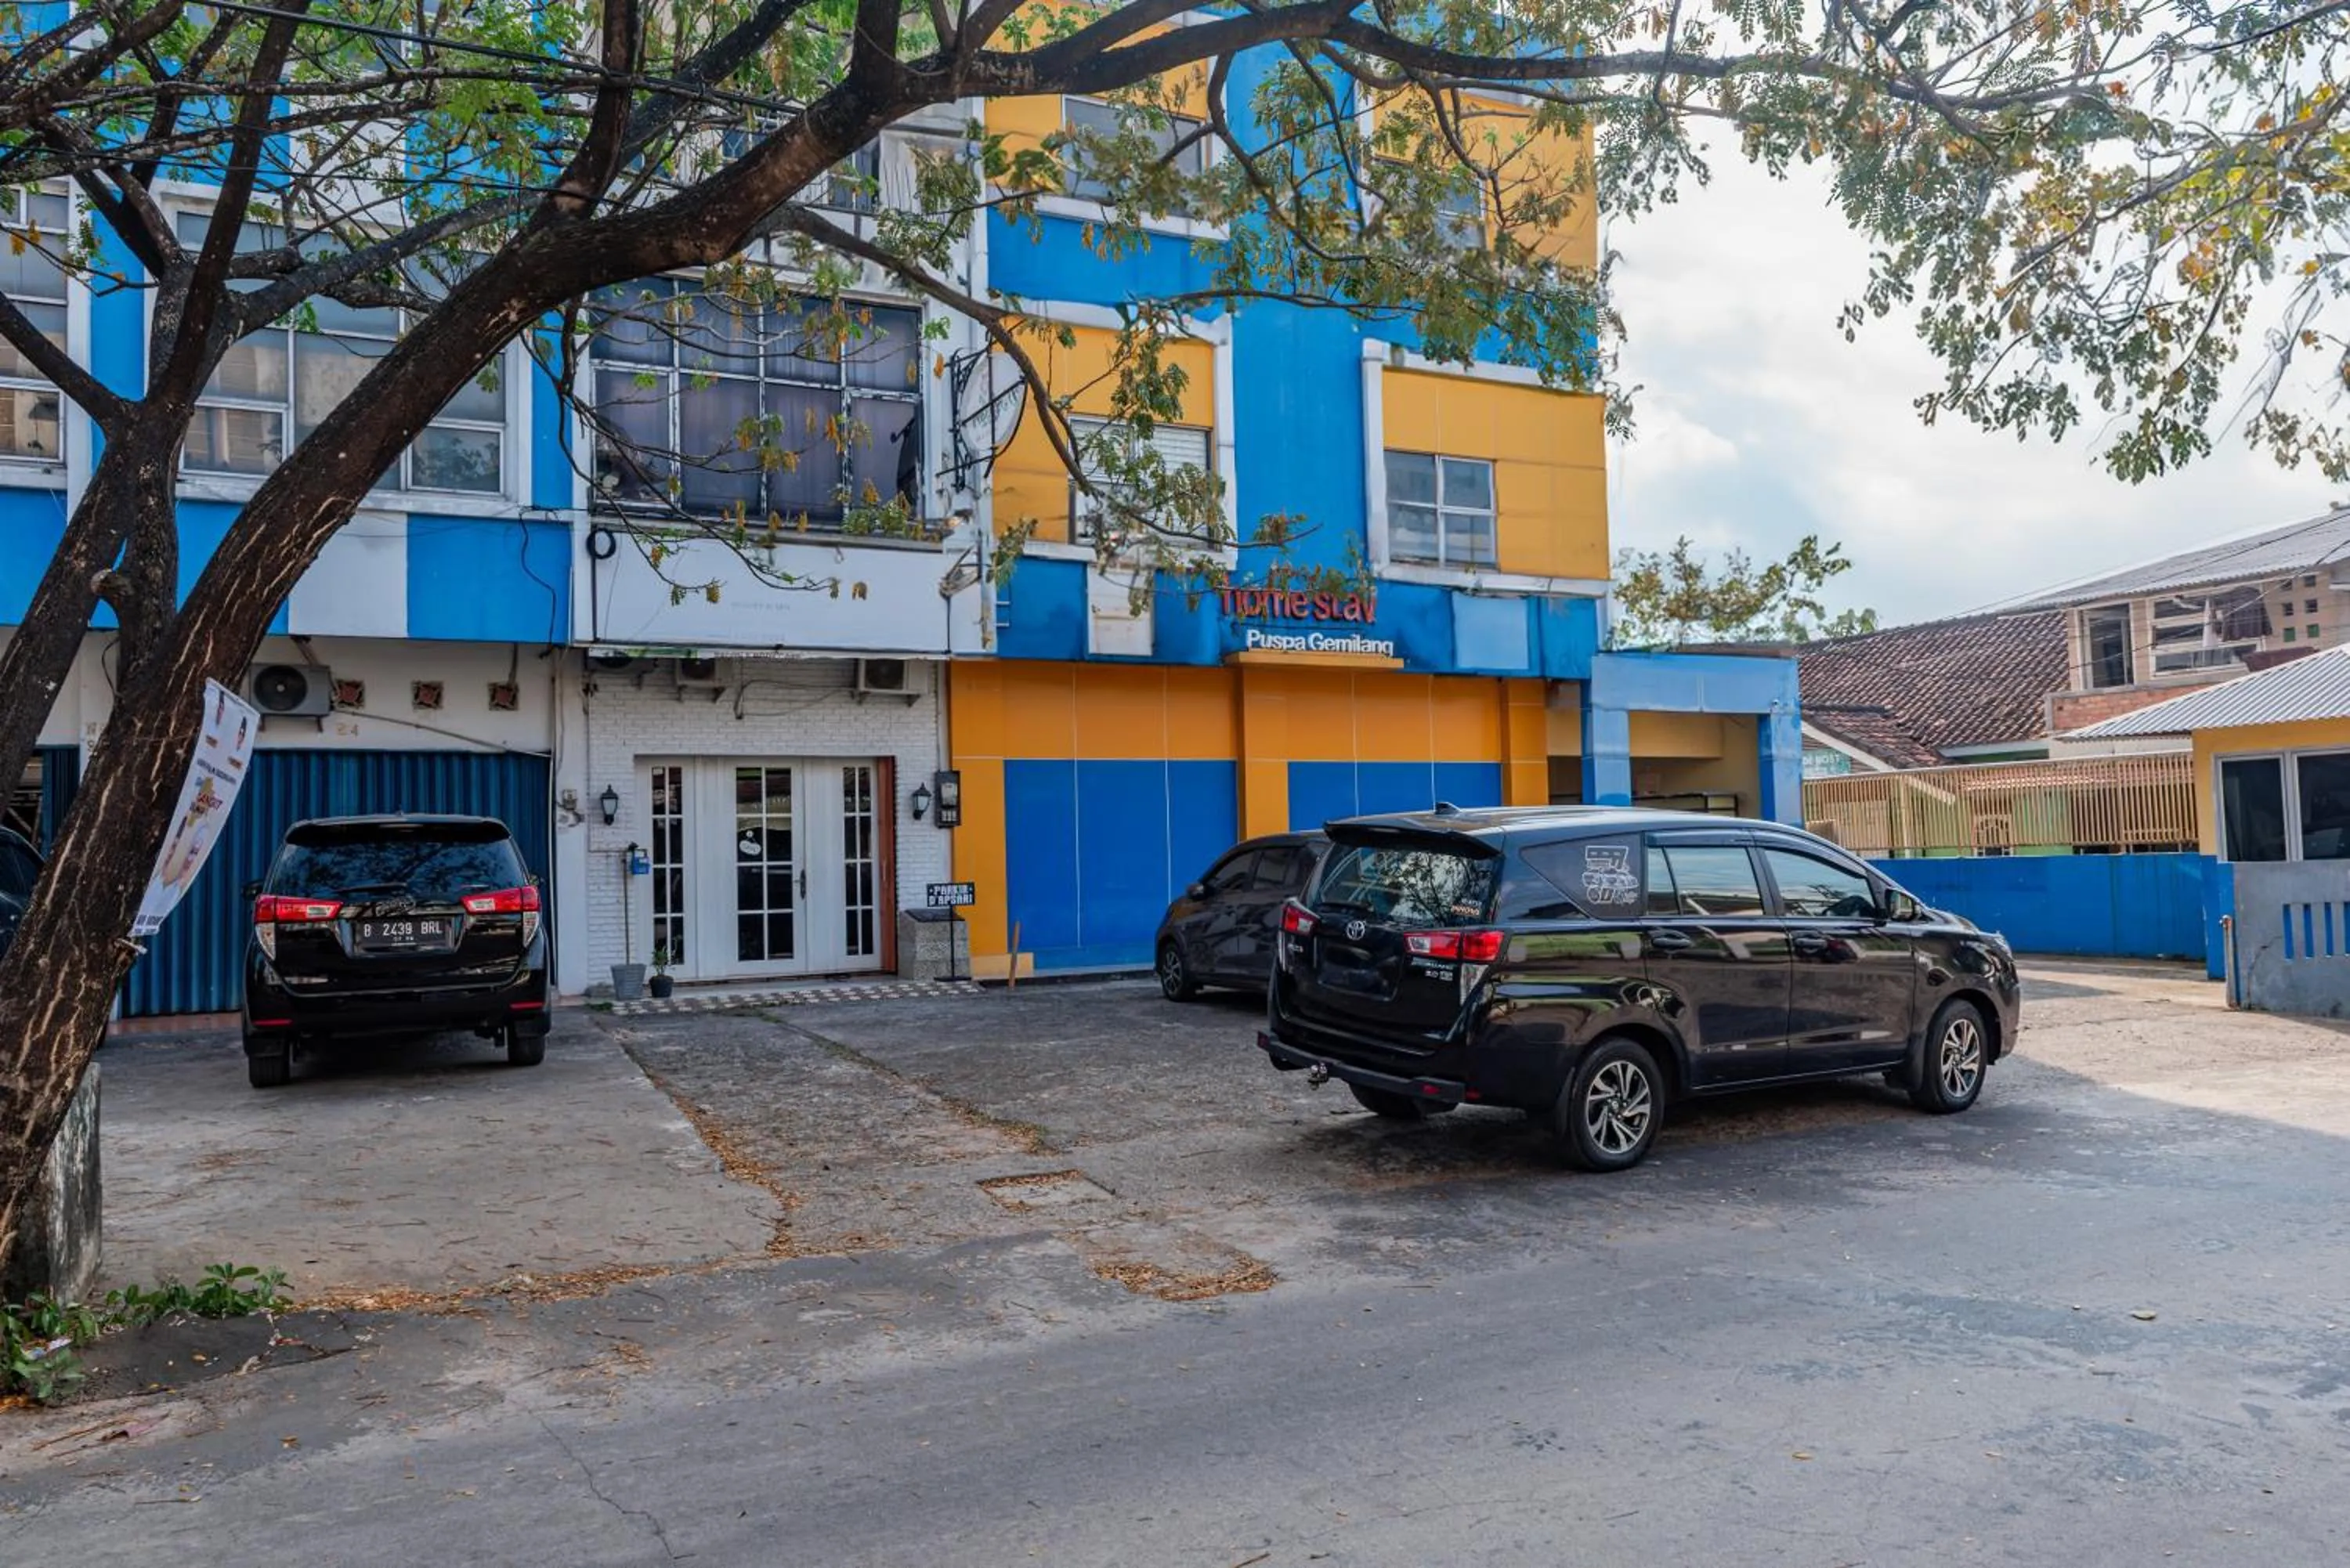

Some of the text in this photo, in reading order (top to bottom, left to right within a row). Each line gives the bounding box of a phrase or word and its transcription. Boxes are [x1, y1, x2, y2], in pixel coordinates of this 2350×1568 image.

[1246, 629, 1394, 657] Puspa Gemilang
[363, 920, 443, 938] B 2439 BRL
